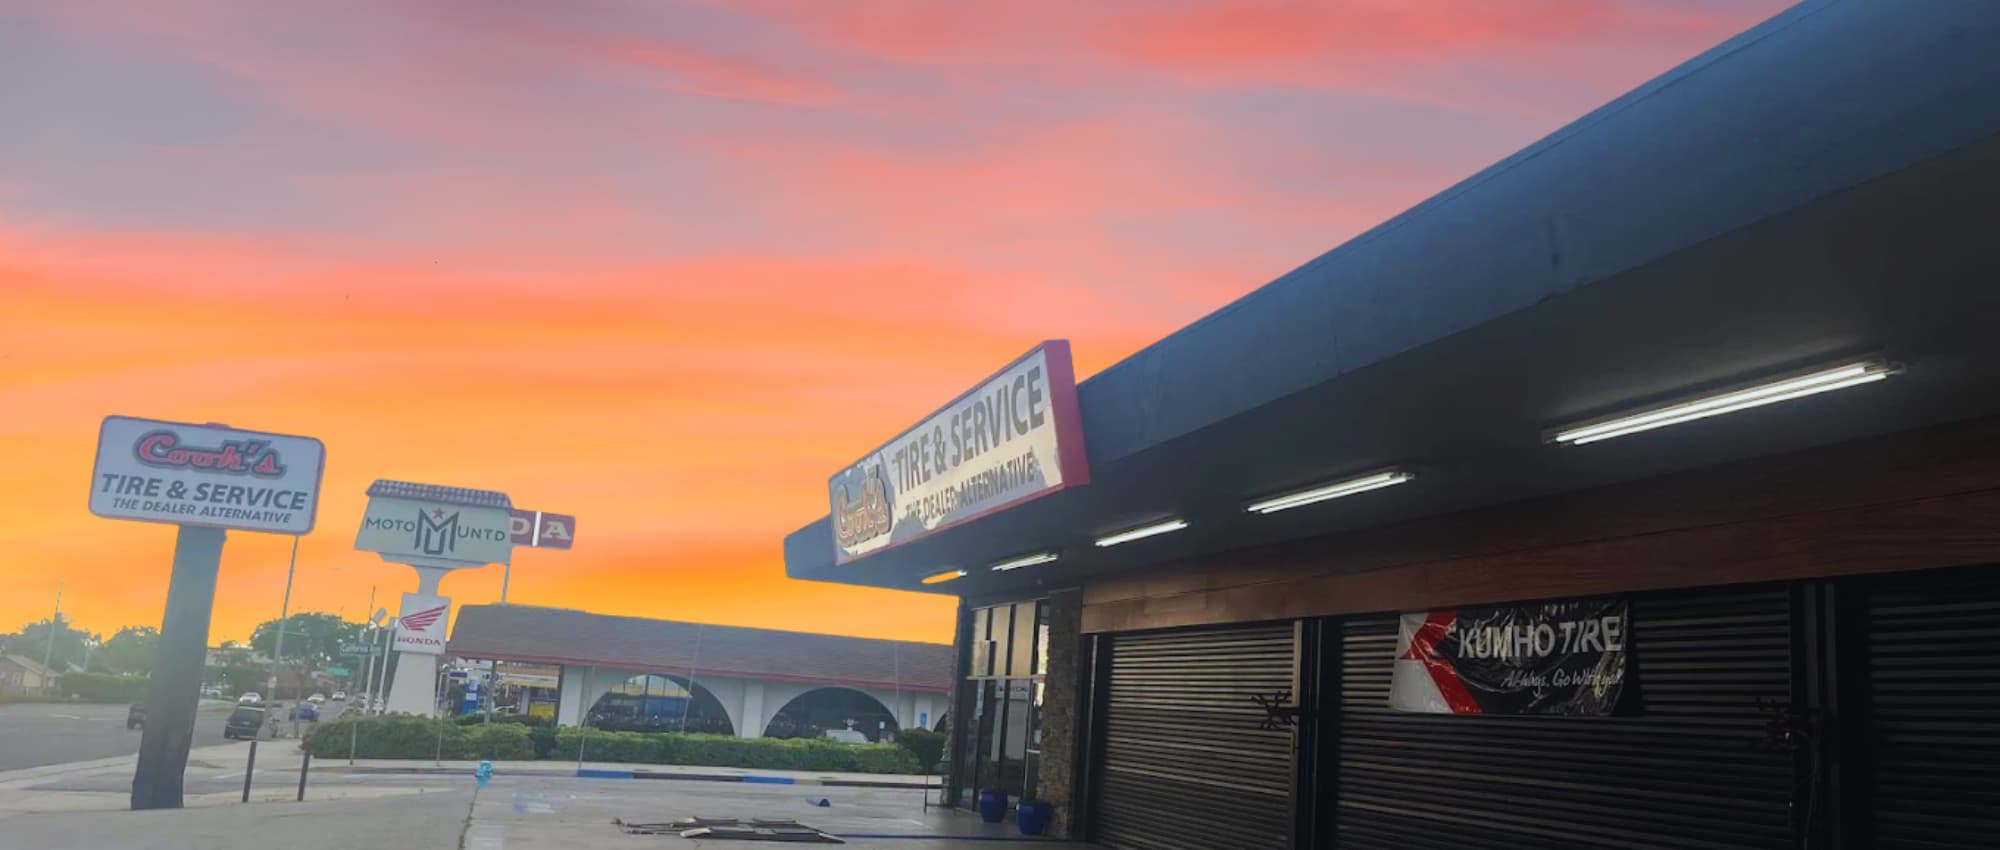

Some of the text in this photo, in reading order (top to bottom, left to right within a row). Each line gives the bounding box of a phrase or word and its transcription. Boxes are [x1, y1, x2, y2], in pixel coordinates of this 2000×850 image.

[893, 366, 1044, 495] TIRE & SERVICE
[135, 431, 286, 478] Cook's
[102, 473, 308, 510] TIRE & SERVICE
[922, 485, 956, 520] DEALER
[960, 451, 1035, 507] ALTERNATIVE
[113, 497, 292, 523] THE DEALER ALTERNATIVE
[365, 517, 416, 532] MOTO
[456, 525, 506, 542] UNTD
[397, 636, 441, 646] HONDA
[1457, 616, 1622, 660] KUMHO TIRE
[1553, 668, 1571, 686] Go
